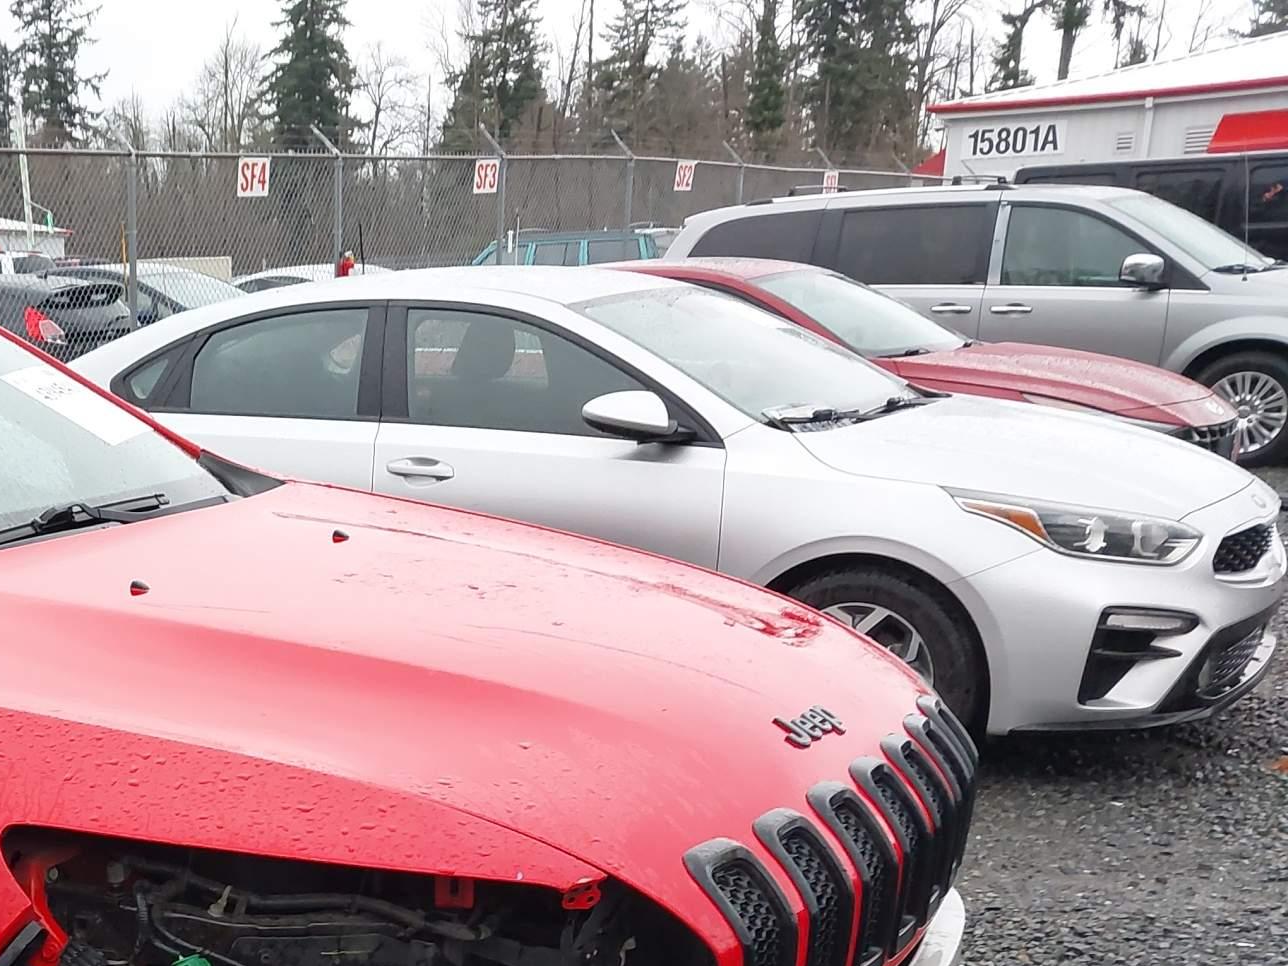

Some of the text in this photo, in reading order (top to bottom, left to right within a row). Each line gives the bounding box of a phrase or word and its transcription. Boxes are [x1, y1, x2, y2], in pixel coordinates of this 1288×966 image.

[968, 124, 1058, 155] 15801A
[241, 162, 266, 192] SF4
[476, 163, 497, 189] SF3
[677, 165, 693, 187] SF2
[772, 705, 846, 750] Jeep
